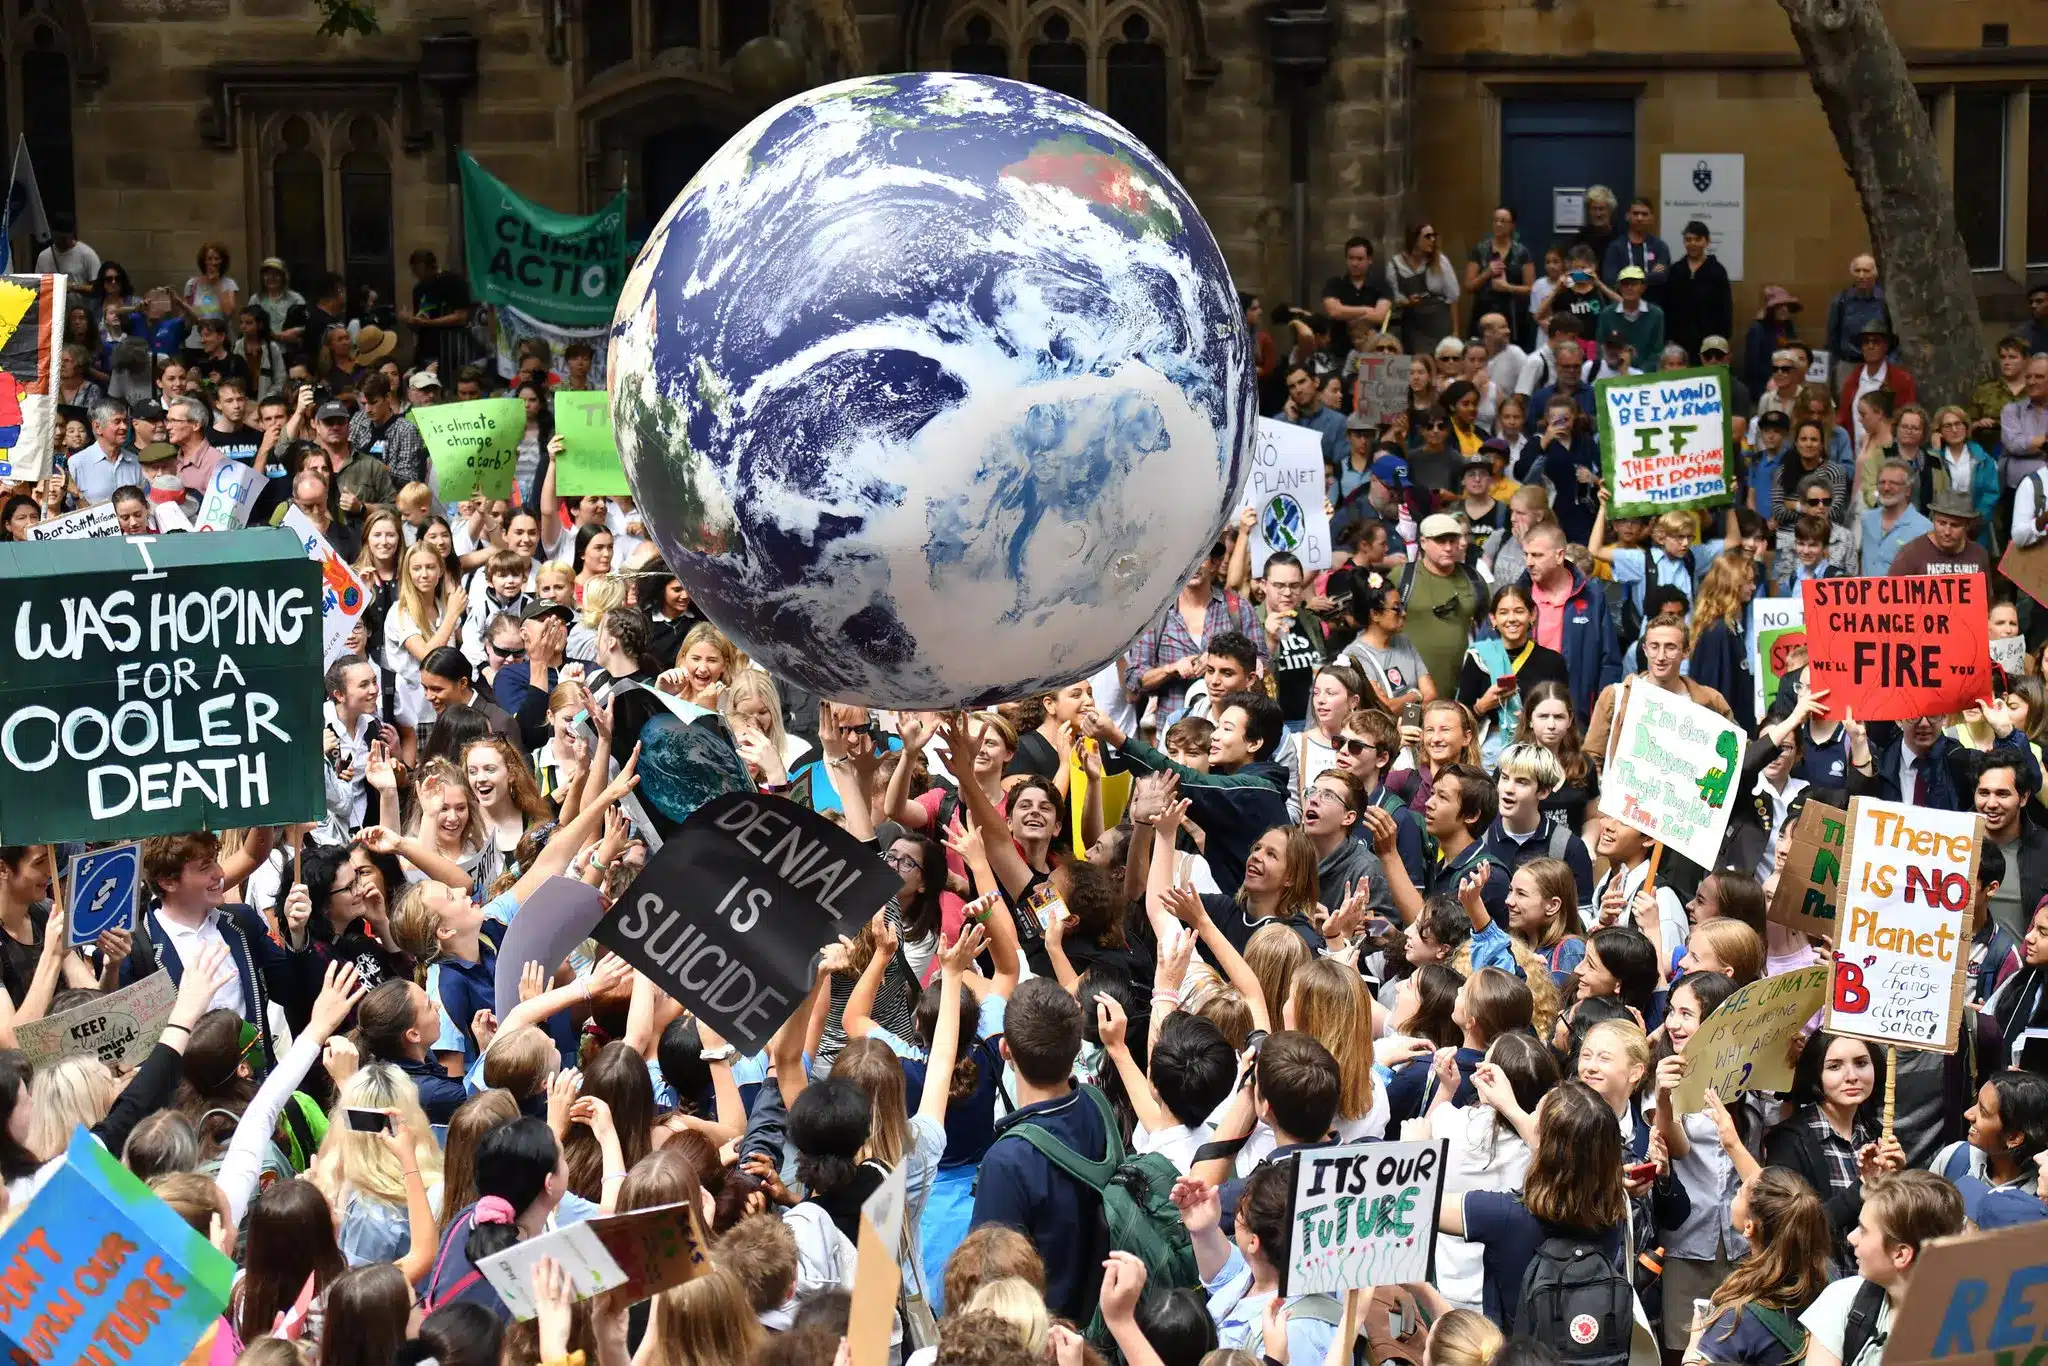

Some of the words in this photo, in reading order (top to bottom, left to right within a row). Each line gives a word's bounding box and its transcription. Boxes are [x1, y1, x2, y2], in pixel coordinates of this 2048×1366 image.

[487, 246, 620, 299] ACTION
[1611, 390, 1651, 406] WE
[433, 420, 444, 434] is
[447, 413, 496, 433] climate
[447, 434, 493, 453] change
[1632, 424, 1699, 458] IF
[467, 457, 475, 469] a
[477, 450, 512, 470] carb?
[1253, 469, 1317, 494] PLANET
[33, 525, 65, 541] Dear
[88, 525, 121, 540] Where
[125, 536, 168, 581] I
[1307, 535, 1322, 564] B
[1814, 579, 1873, 606] STOP
[1877, 578, 1972, 605] CLIMATE
[14, 589, 142, 661] WAS
[150, 585, 313, 652] HOPING
[1763, 612, 1790, 627] NO
[1829, 612, 1916, 634] CHANGE
[1923, 614, 1951, 635] OR
[116, 658, 201, 702] FOR
[212, 654, 247, 689] A
[1812, 659, 1849, 673] WE'LL
[1853, 641, 1943, 689] FIRE
[1949, 665, 1976, 676] YOU
[1641, 698, 1677, 731] I'm
[1, 692, 293, 772] COOLER
[87, 751, 270, 820] DEATH
[1622, 793, 1658, 830] Time
[1867, 808, 1973, 864] There
[712, 799, 863, 921] DENIAL
[1903, 864, 1973, 913] NO
[714, 875, 773, 934] IS
[1848, 905, 1955, 964] Planet
[616, 891, 791, 1042] SUICIDE
[1889, 961, 1931, 979] Let's
[1757, 970, 1828, 1007] CLIMATE
[1881, 977, 1940, 1000] change
[1888, 993, 1916, 1008] for
[70, 1015, 107, 1041] KEEP
[1871, 1004, 1940, 1024] climate
[98, 1026, 139, 1056] mind-
[1709, 1023, 1725, 1044] IS
[1878, 1023, 1938, 1040] sake!
[1714, 1043, 1744, 1070] WHY
[1306, 1153, 1370, 1197] IT'S
[1376, 1148, 1437, 1187] OUR
[1296, 1186, 1421, 1257] FUTURE
[73, 1230, 140, 1297] OUR
